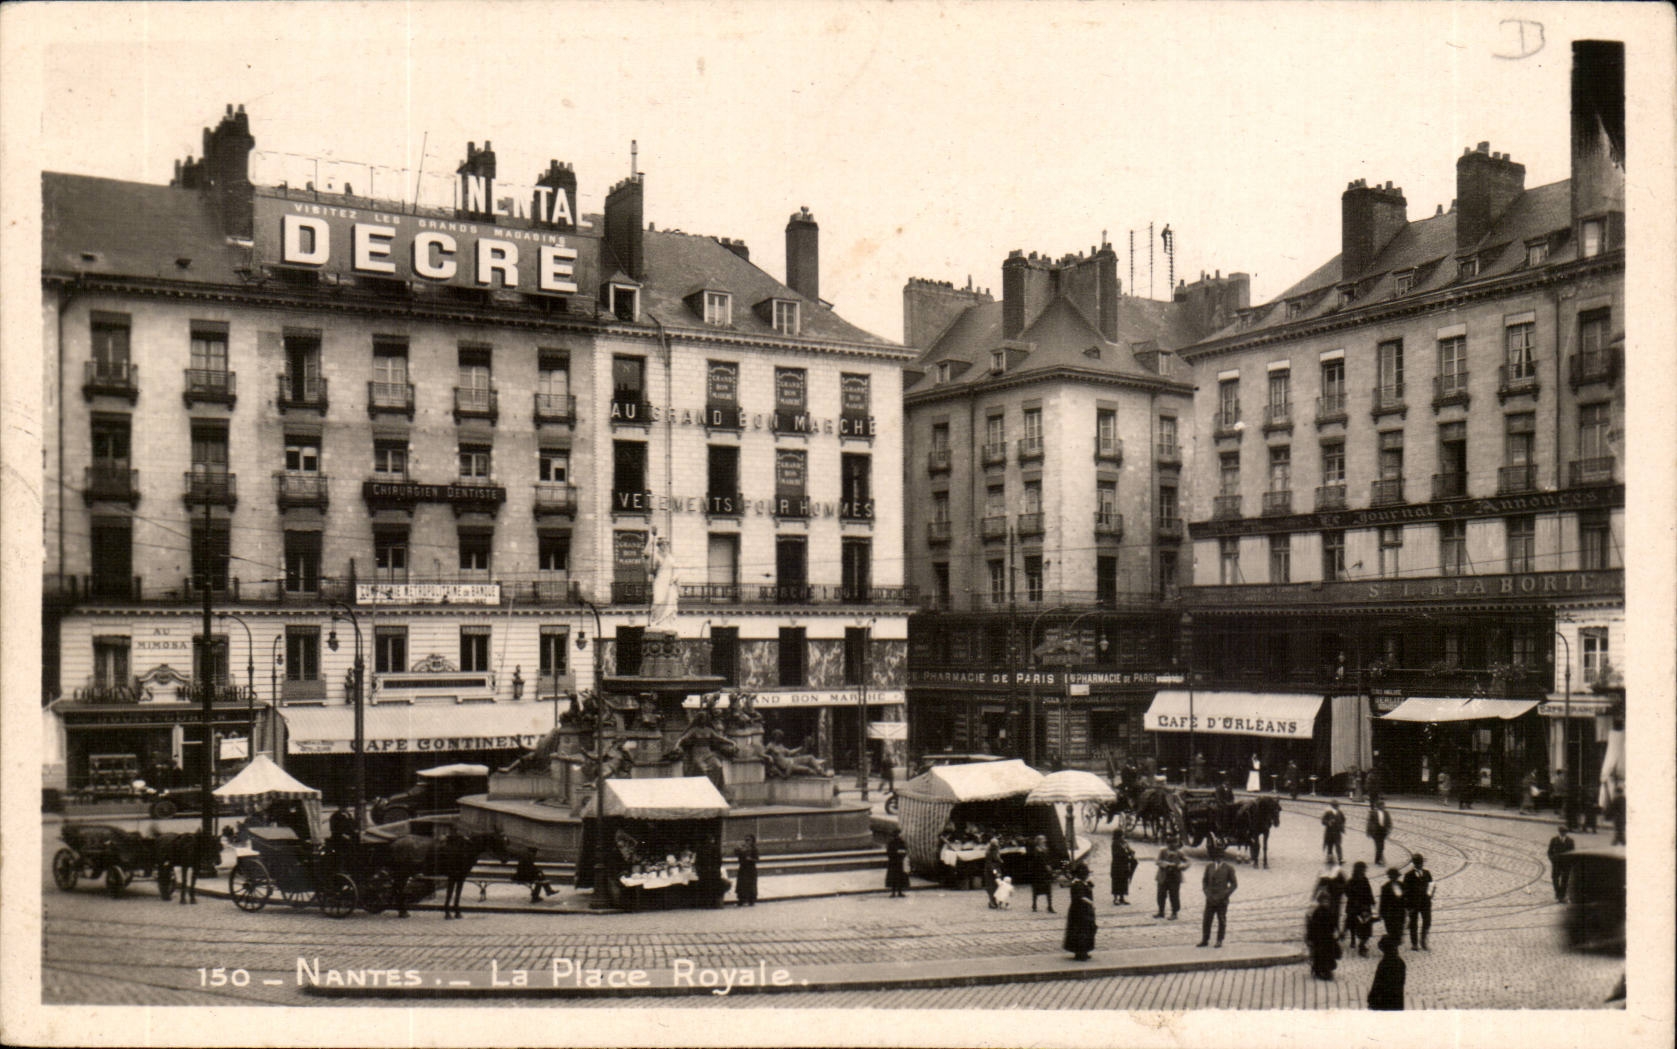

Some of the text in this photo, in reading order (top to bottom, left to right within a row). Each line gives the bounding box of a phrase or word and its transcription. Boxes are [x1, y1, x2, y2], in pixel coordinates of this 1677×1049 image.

[294, 204, 567, 245] VISITEZ LES GRANDS MAGASINS
[611, 402, 636, 418] AU
[651, 407, 722, 426] GRAND
[738, 411, 779, 432] BON
[373, 484, 497, 499] CHIRURGIEN DENTISTE
[741, 499, 789, 516] POUR
[800, 500, 873, 518] HOMMES
[1501, 573, 1593, 592] BORIE
[153, 628, 170, 636] AU
[138, 641, 188, 649] MIMOSA
[924, 671, 985, 683] PHARMACIE
[992, 674, 1008, 683] DE
[1016, 672, 1055, 684] PARIS
[1076, 673, 1121, 683] PHARMACIE
[791, 695, 819, 703] BON
[1207, 716, 1297, 733] D'ORLÉANS
